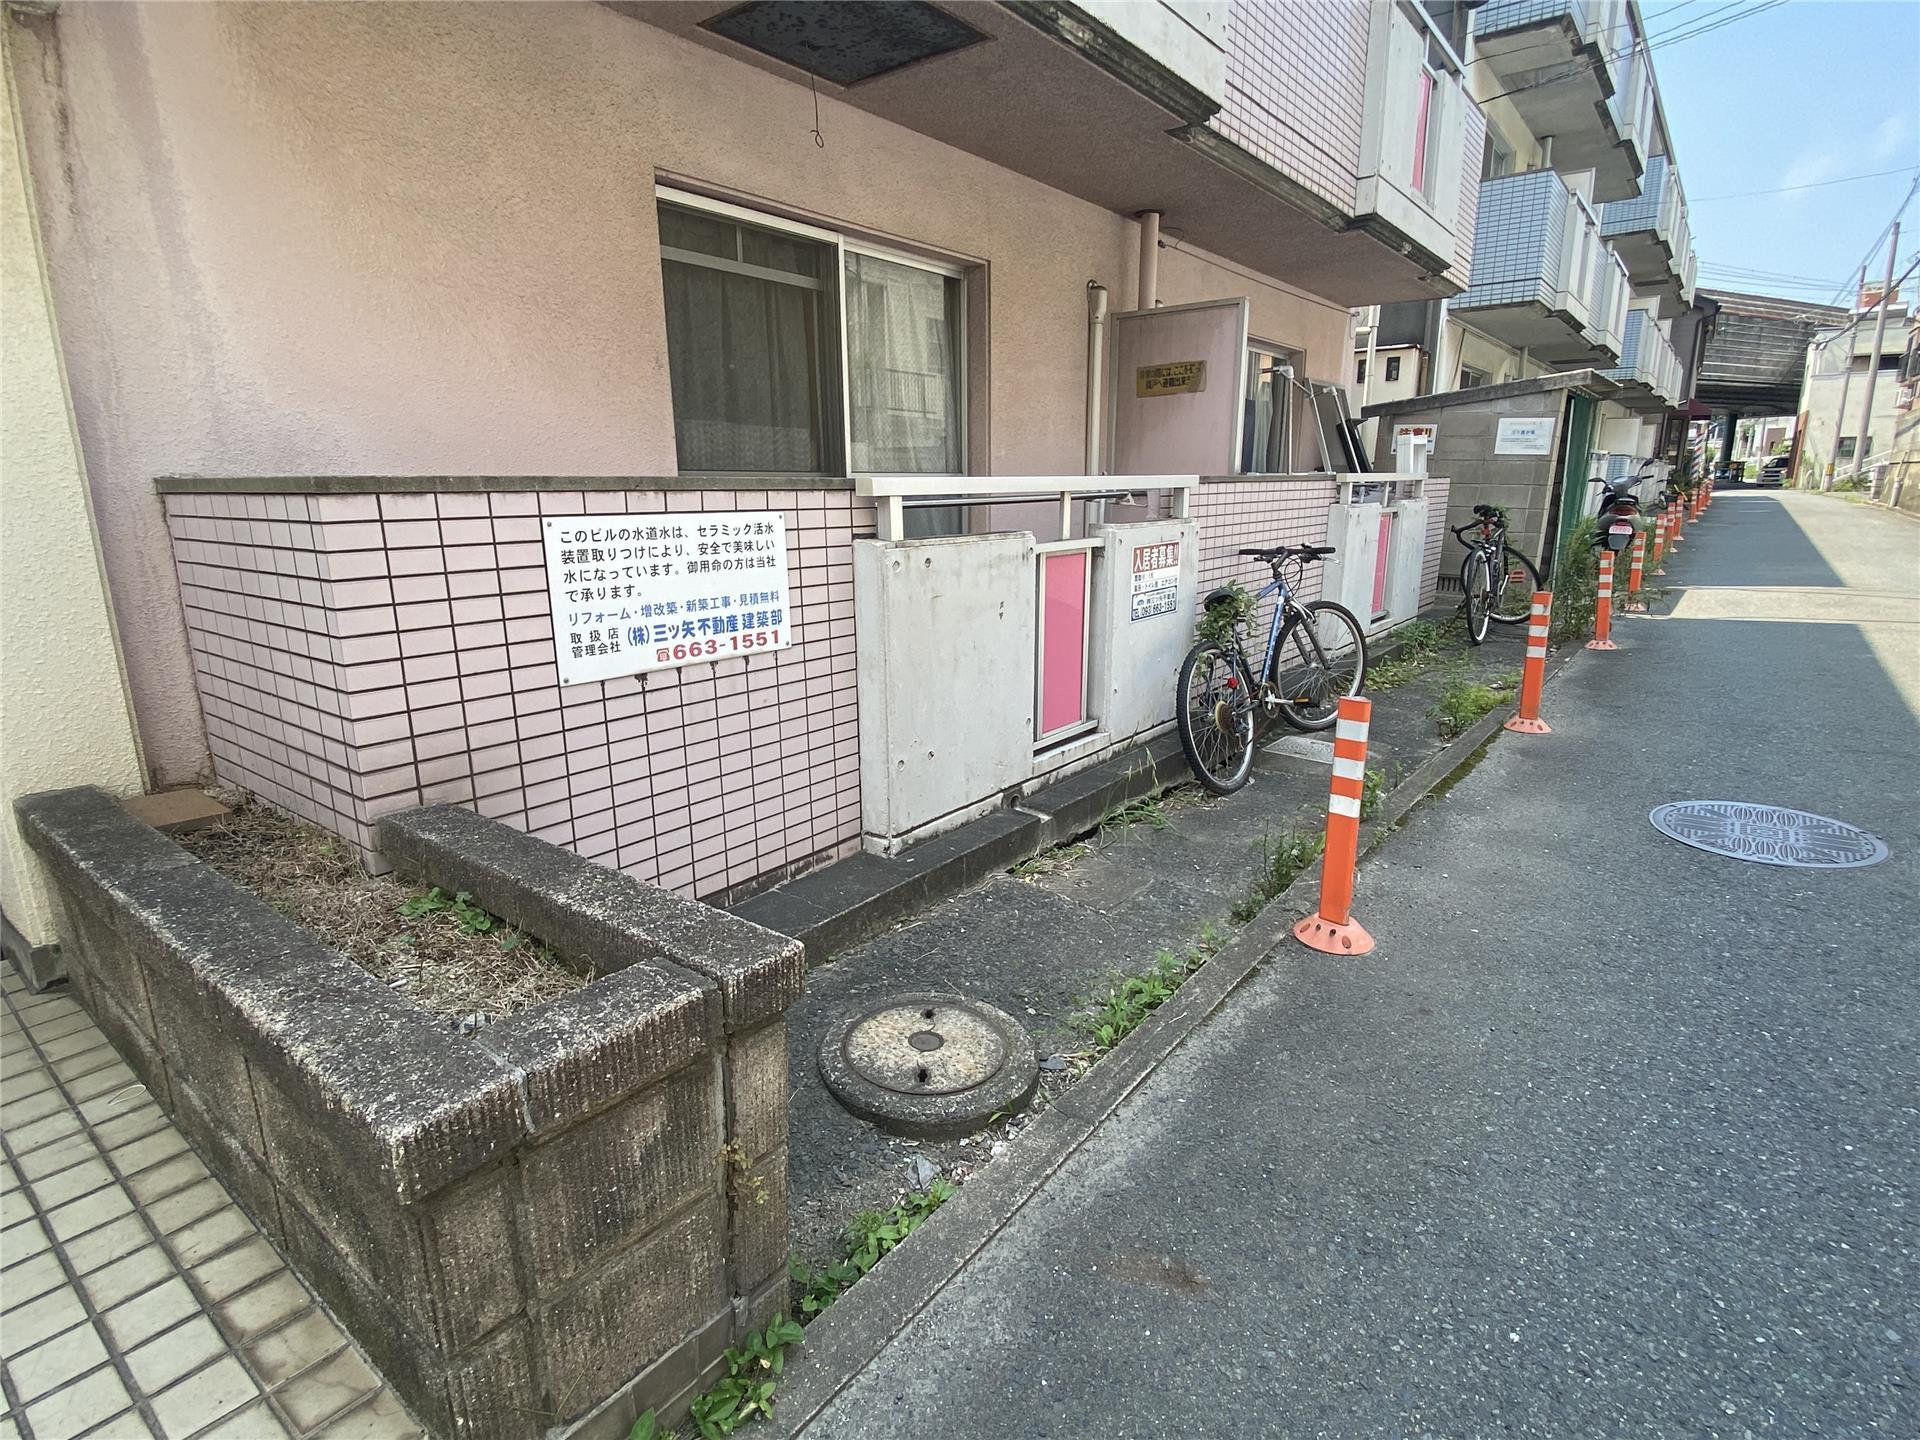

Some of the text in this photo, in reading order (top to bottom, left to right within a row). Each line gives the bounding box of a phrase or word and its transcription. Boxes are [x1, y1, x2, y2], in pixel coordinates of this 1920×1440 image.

[565, 584, 642, 602] で承ります。
[571, 641, 622, 659] 管理会社
[673, 629, 779, 660] 663-1551
